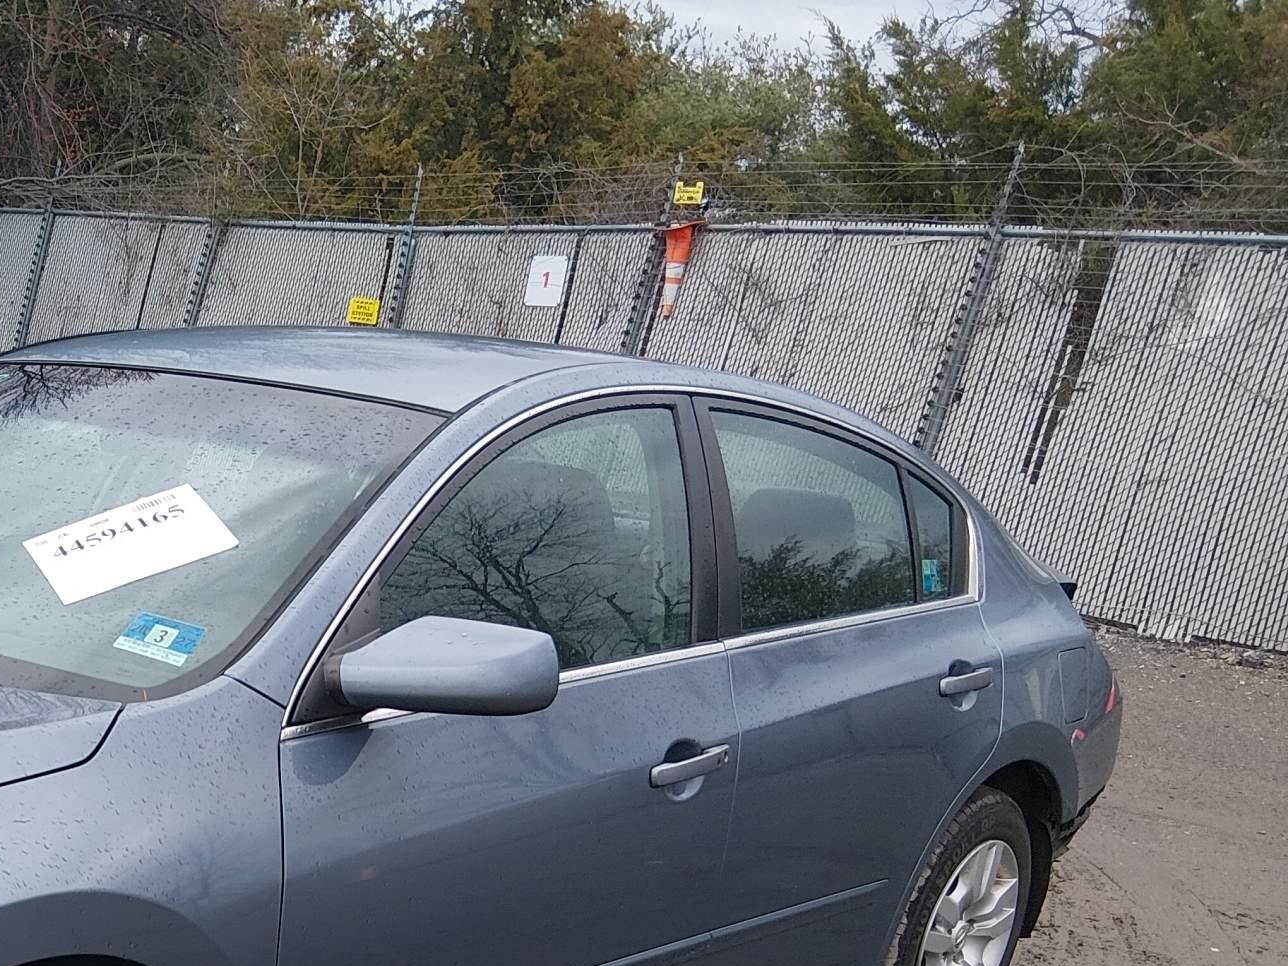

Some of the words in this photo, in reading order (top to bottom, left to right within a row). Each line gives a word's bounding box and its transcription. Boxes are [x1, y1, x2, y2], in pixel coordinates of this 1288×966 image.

[542, 271, 550, 288] 1
[53, 504, 185, 557] 44594165
[153, 630, 168, 643] 3
